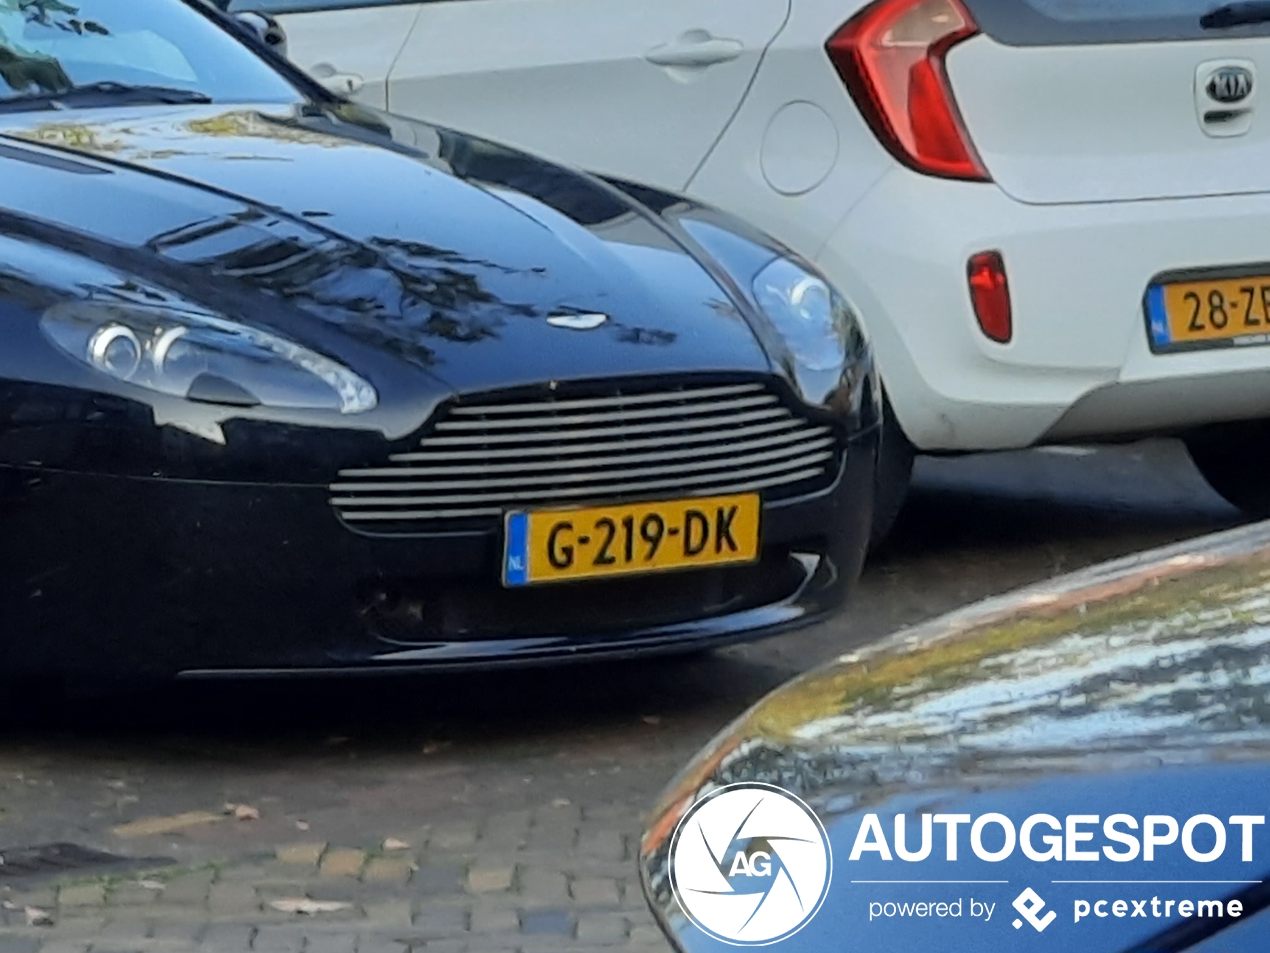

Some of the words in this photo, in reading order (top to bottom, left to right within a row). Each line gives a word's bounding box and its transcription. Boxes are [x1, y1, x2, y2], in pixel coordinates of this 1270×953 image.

[1213, 73, 1248, 97] KIA
[547, 505, 738, 570] G-219-DK
[508, 555, 525, 571] NL
